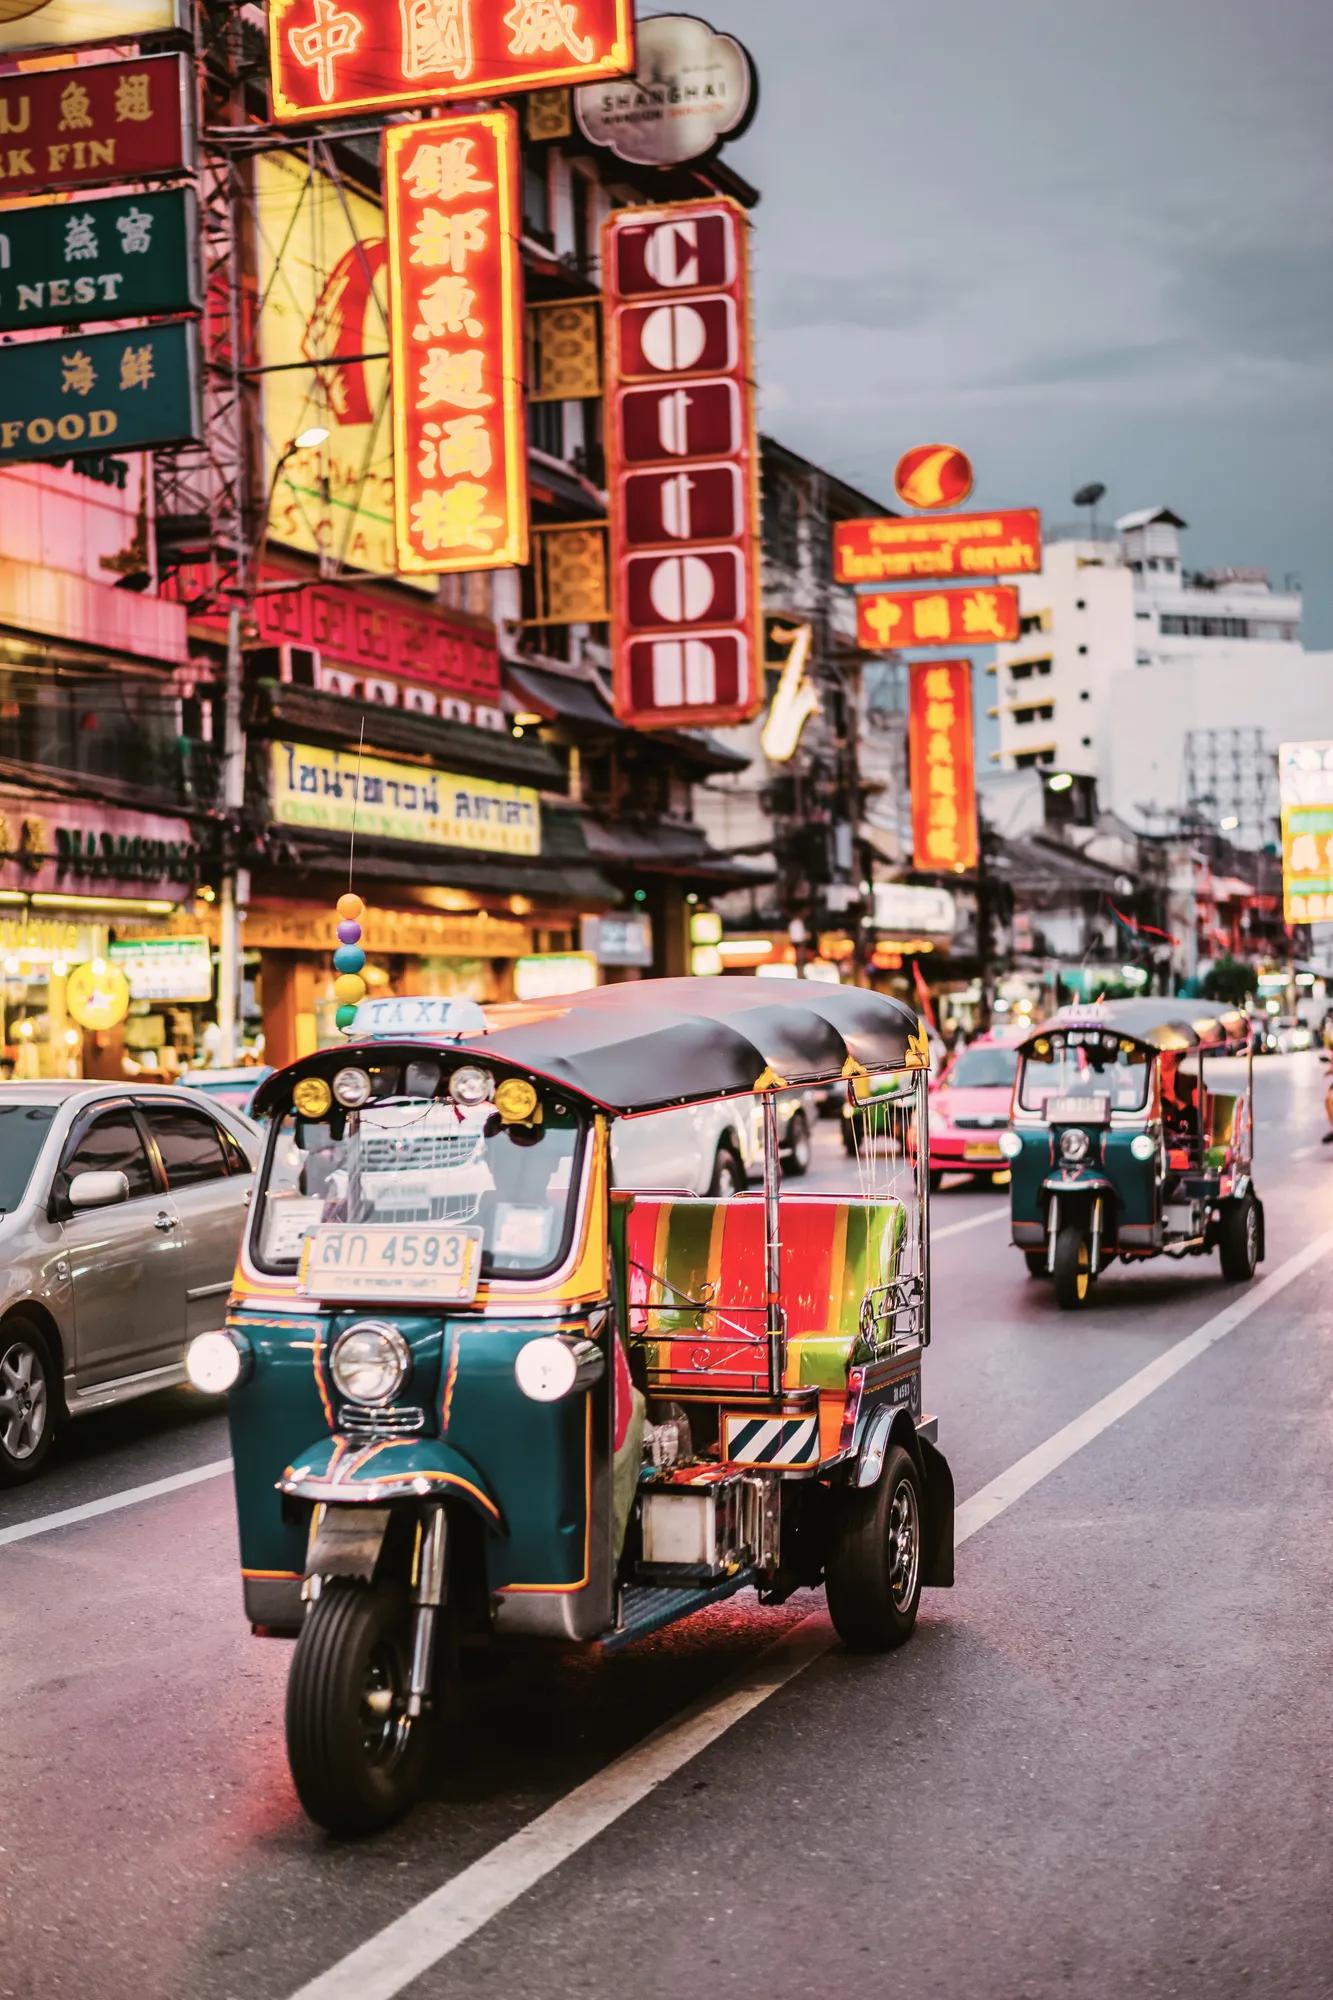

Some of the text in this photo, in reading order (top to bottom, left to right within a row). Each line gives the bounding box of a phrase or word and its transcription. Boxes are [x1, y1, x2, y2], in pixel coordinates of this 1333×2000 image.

[58, 73, 154, 132] 魚翅
[602, 82, 727, 112] SHANGHAI
[48, 138, 117, 172] FIN
[16, 273, 124, 311] NEST
[61, 343, 156, 396] 海鮮
[1, 409, 118, 448] FOOD
[371, 1001, 452, 1024] TAXI
[322, 1231, 368, 1266] สก
[381, 1234, 461, 1268] 4593
